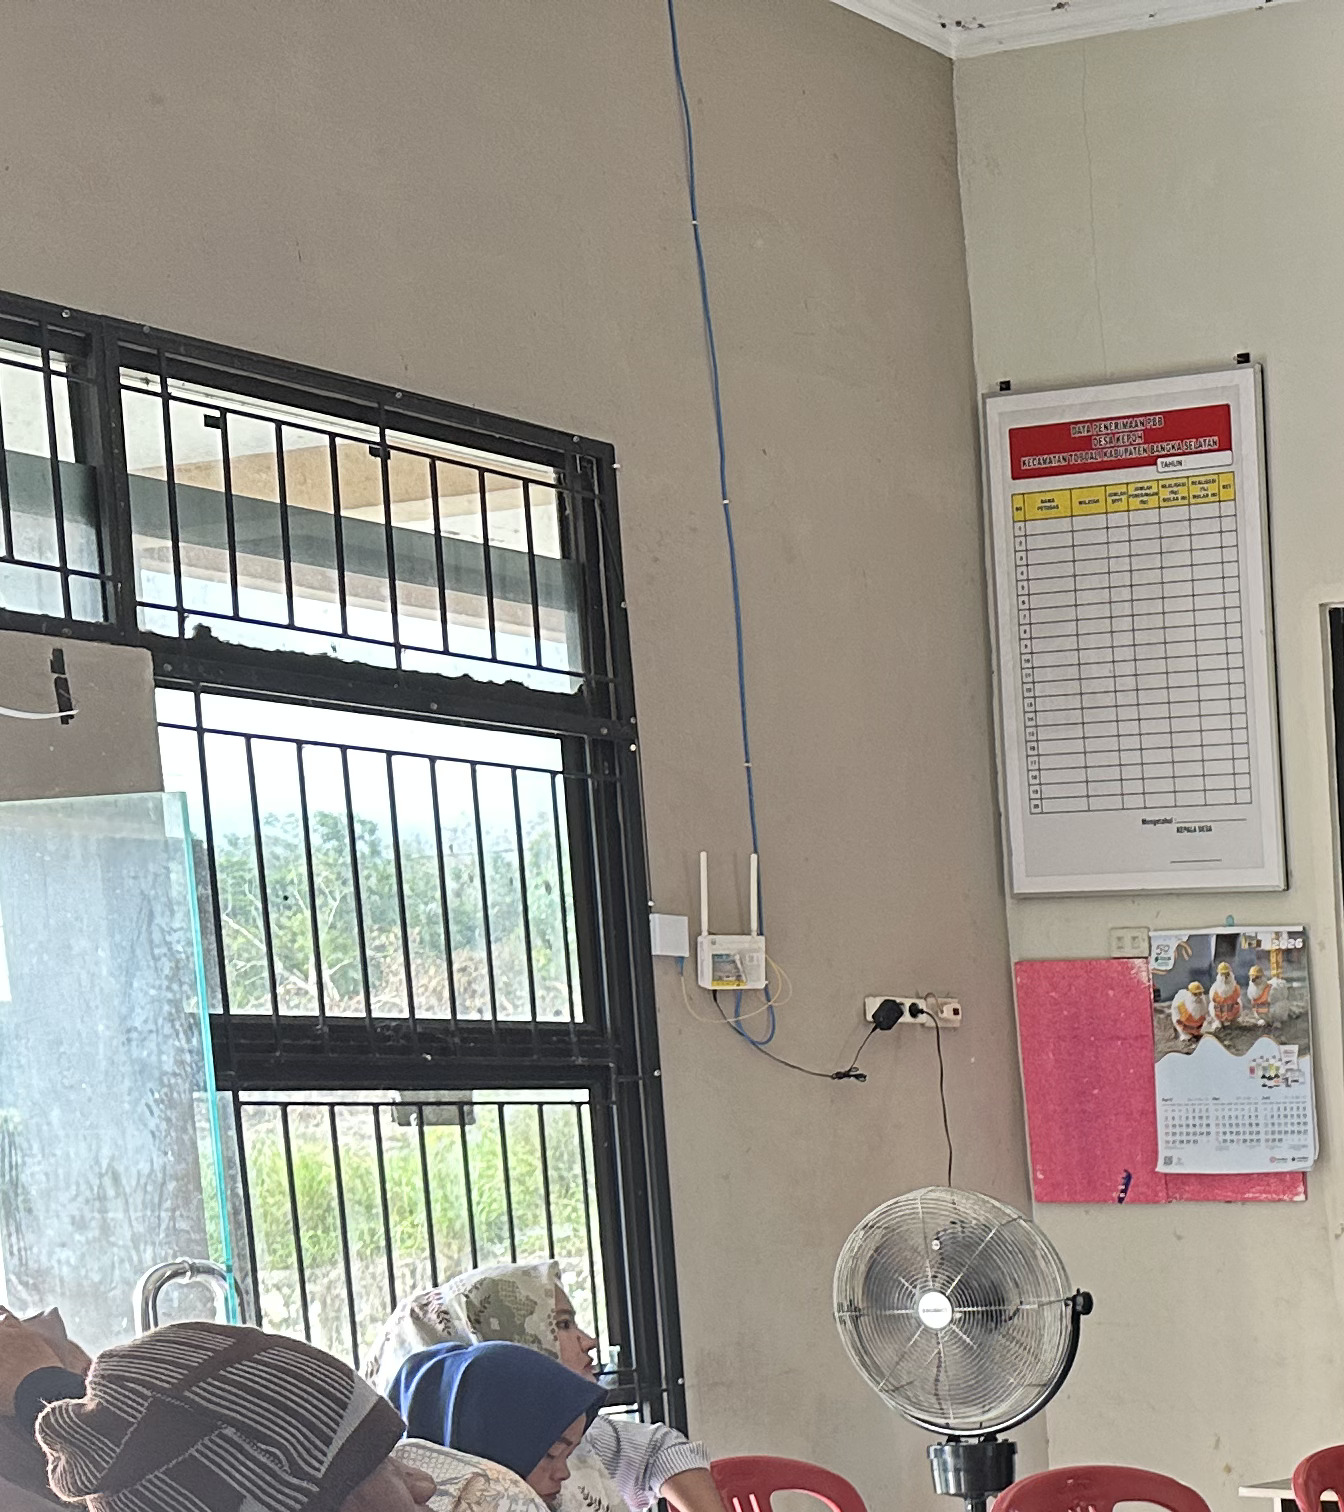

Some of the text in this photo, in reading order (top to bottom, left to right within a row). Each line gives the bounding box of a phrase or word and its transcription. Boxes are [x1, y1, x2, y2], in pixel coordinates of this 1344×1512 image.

[1072, 416, 1164, 437] DATA PENERIMAAN PBB
[1092, 432, 1143, 448] DESA KEPOH
[1021, 437, 1218, 469] KECAMATAN TOBOALI KABUPATEN BANGKA SELATAN
